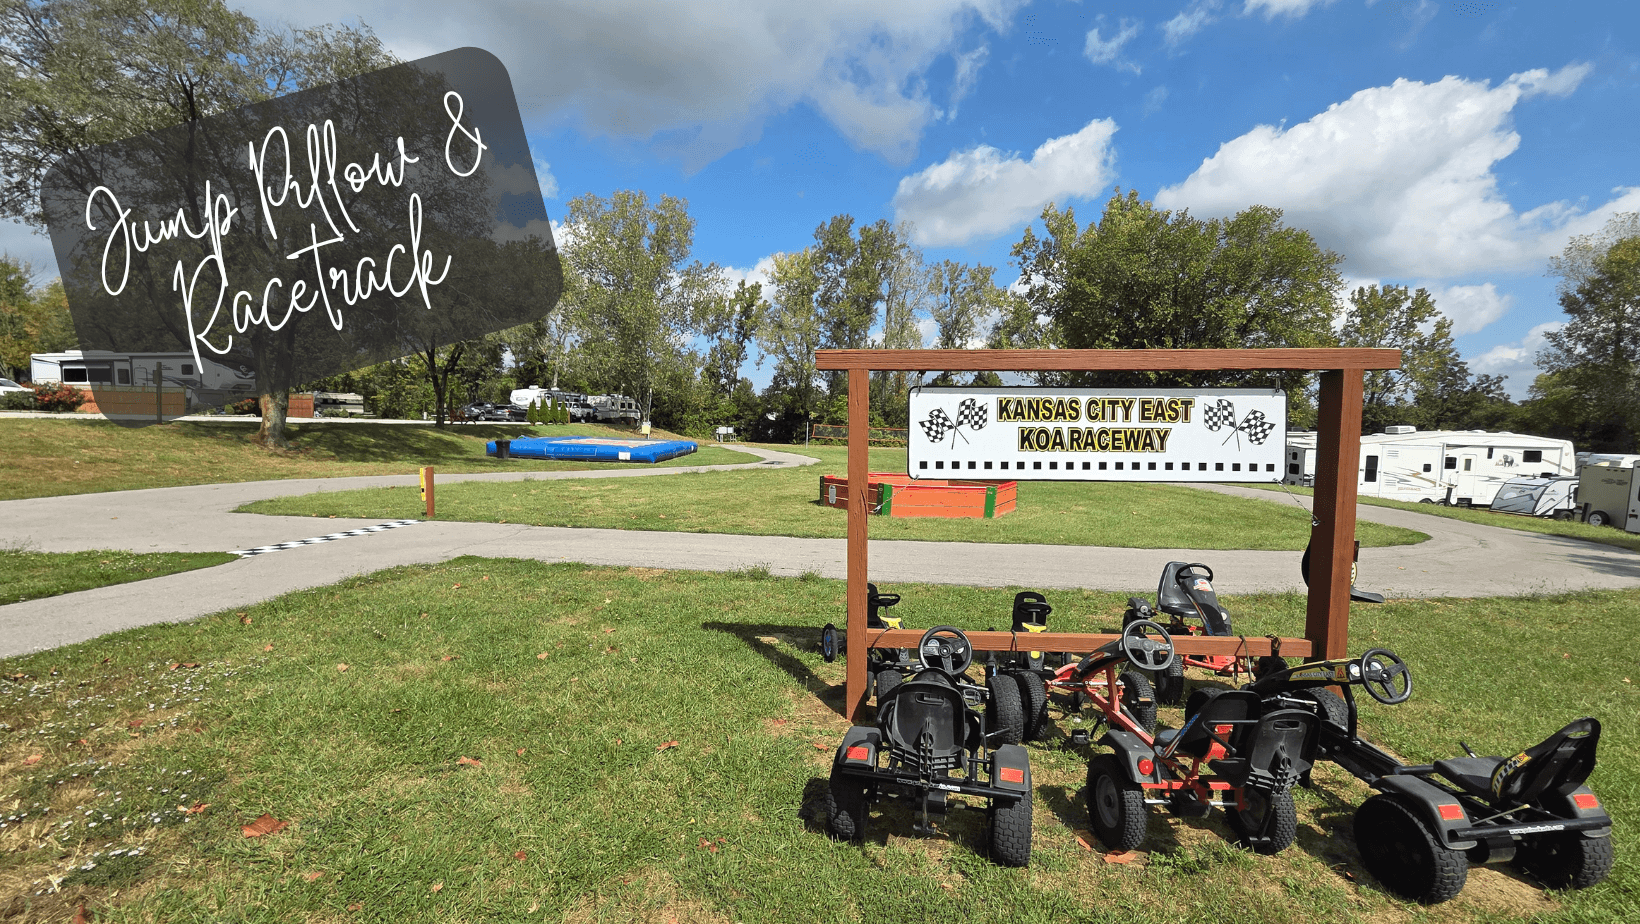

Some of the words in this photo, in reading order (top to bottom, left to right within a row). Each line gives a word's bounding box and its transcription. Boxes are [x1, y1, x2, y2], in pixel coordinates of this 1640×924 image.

[997, 397, 1081, 422] KANSAS
[1086, 397, 1137, 423] CITY
[1138, 397, 1195, 423] EAST
[1018, 427, 1067, 452] KOA
[1069, 427, 1171, 453] RACEWAY
